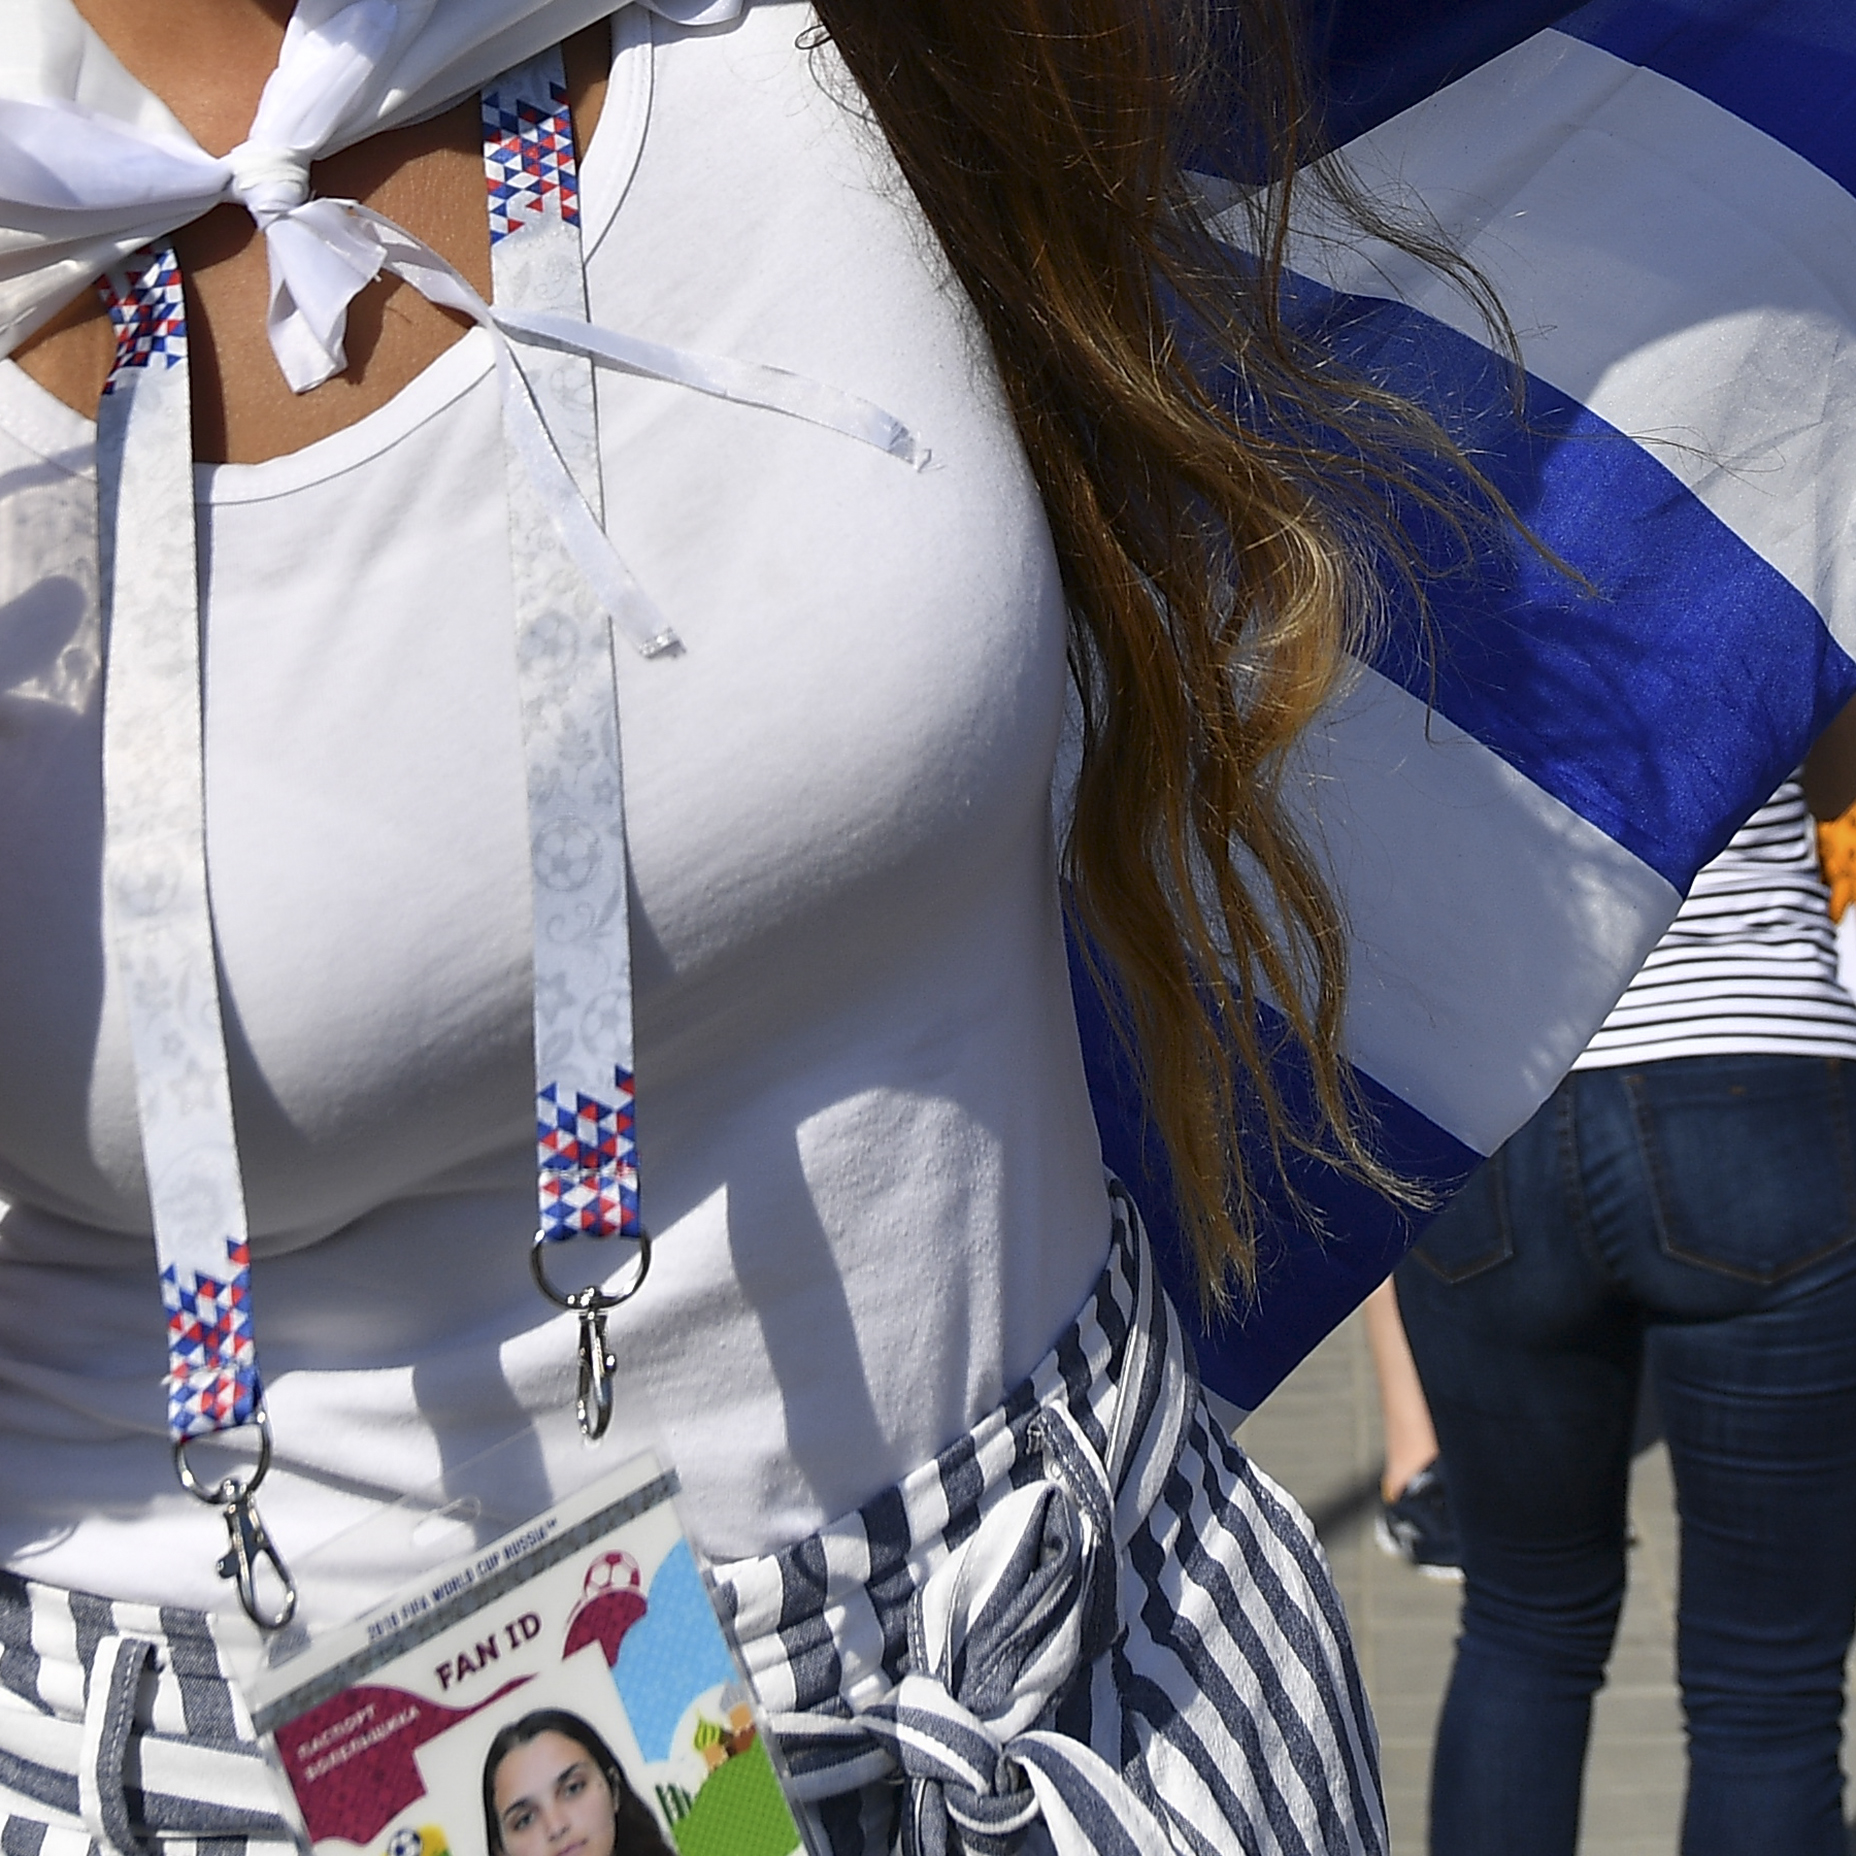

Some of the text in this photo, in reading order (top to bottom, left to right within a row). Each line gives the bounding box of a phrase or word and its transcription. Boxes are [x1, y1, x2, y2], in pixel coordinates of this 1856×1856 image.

[431, 1567, 475, 1603] WORLD
[477, 1550, 501, 1576] CUP
[434, 1611, 542, 1692] FAN ID
